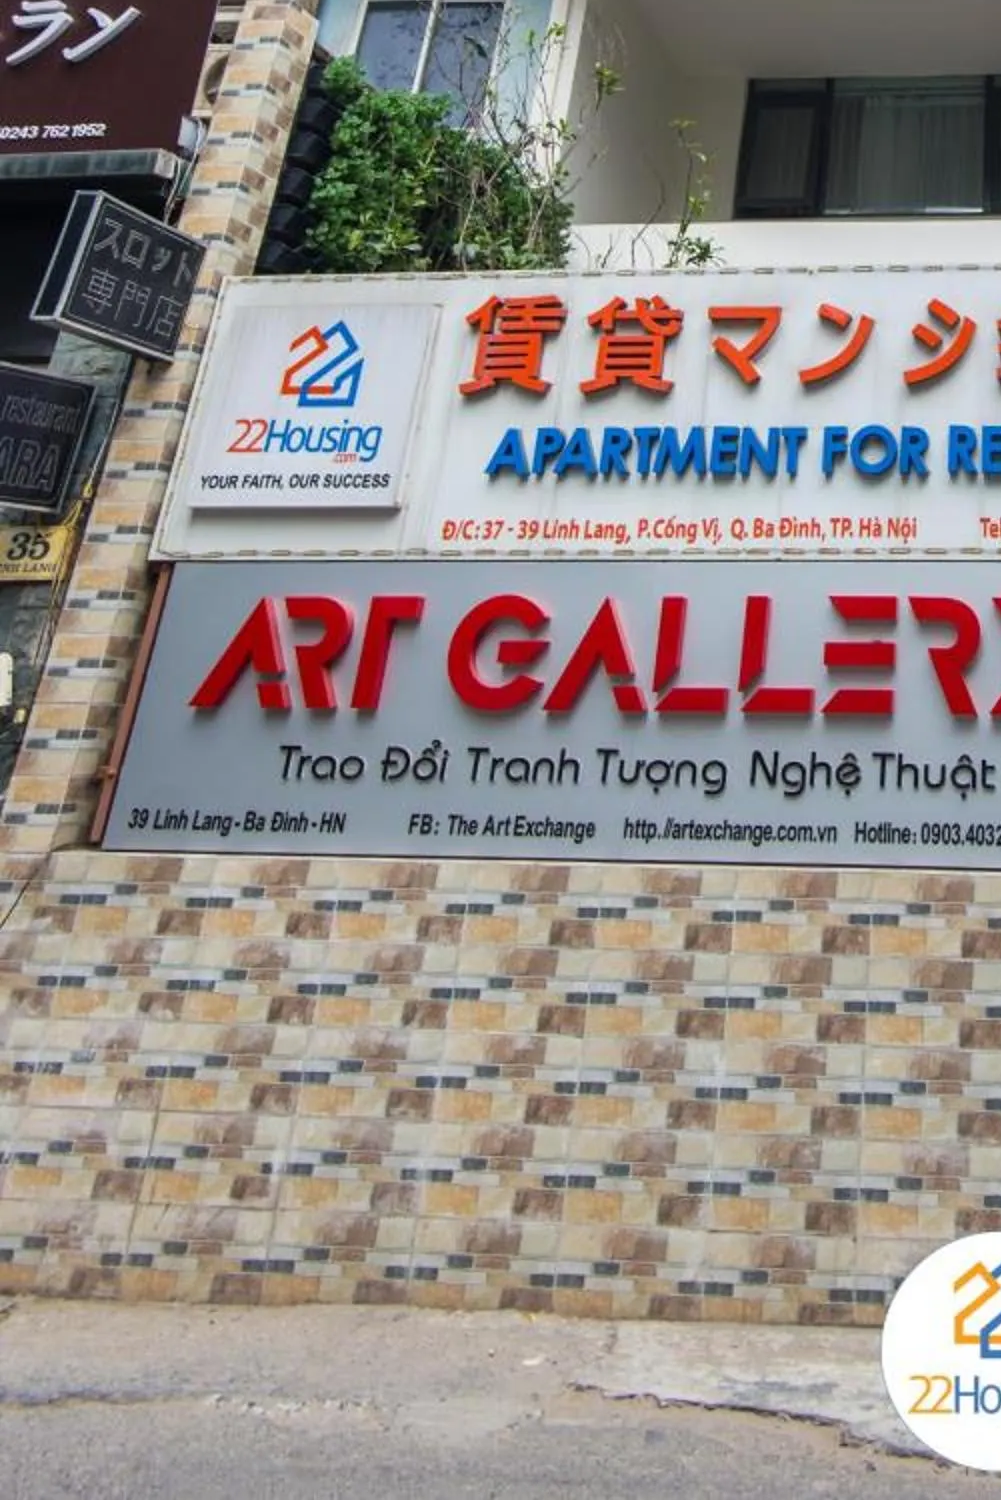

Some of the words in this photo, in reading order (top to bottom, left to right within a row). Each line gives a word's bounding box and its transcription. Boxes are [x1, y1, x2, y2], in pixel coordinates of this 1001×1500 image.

[226, 418, 383, 463] 22Housing
[483, 425, 809, 477] APARTMENT
[819, 424, 930, 477] FOR
[201, 474, 239, 489] YOUR
[241, 475, 284, 490] FAITH,
[289, 473, 321, 489] OUR
[323, 473, 392, 489] SUCCESS
[517, 520, 540, 540] 39
[543, 518, 580, 540] Linh
[583, 519, 631, 544] Lang,
[730, 519, 748, 540] Q.
[752, 518, 775, 540] Ba
[778, 517, 827, 542] Đình,
[830, 518, 853, 540] TP.
[858, 518, 882, 540] Hà
[887, 517, 917, 544] Nội
[7, 531, 50, 560] 35
[188, 595, 426, 711] ART
[279, 745, 365, 782] Trao
[381, 739, 450, 783] Đổi
[467, 747, 581, 785] Tranh
[596, 748, 727, 797] Tượng
[749, 750, 861, 798] Nghệ
[872, 752, 997, 800] Thuật
[128, 808, 149, 829] 39
[152, 808, 189, 831] Linh
[408, 814, 440, 835] FB:
[448, 814, 478, 836] The
[854, 822, 917, 845] Hotline:
